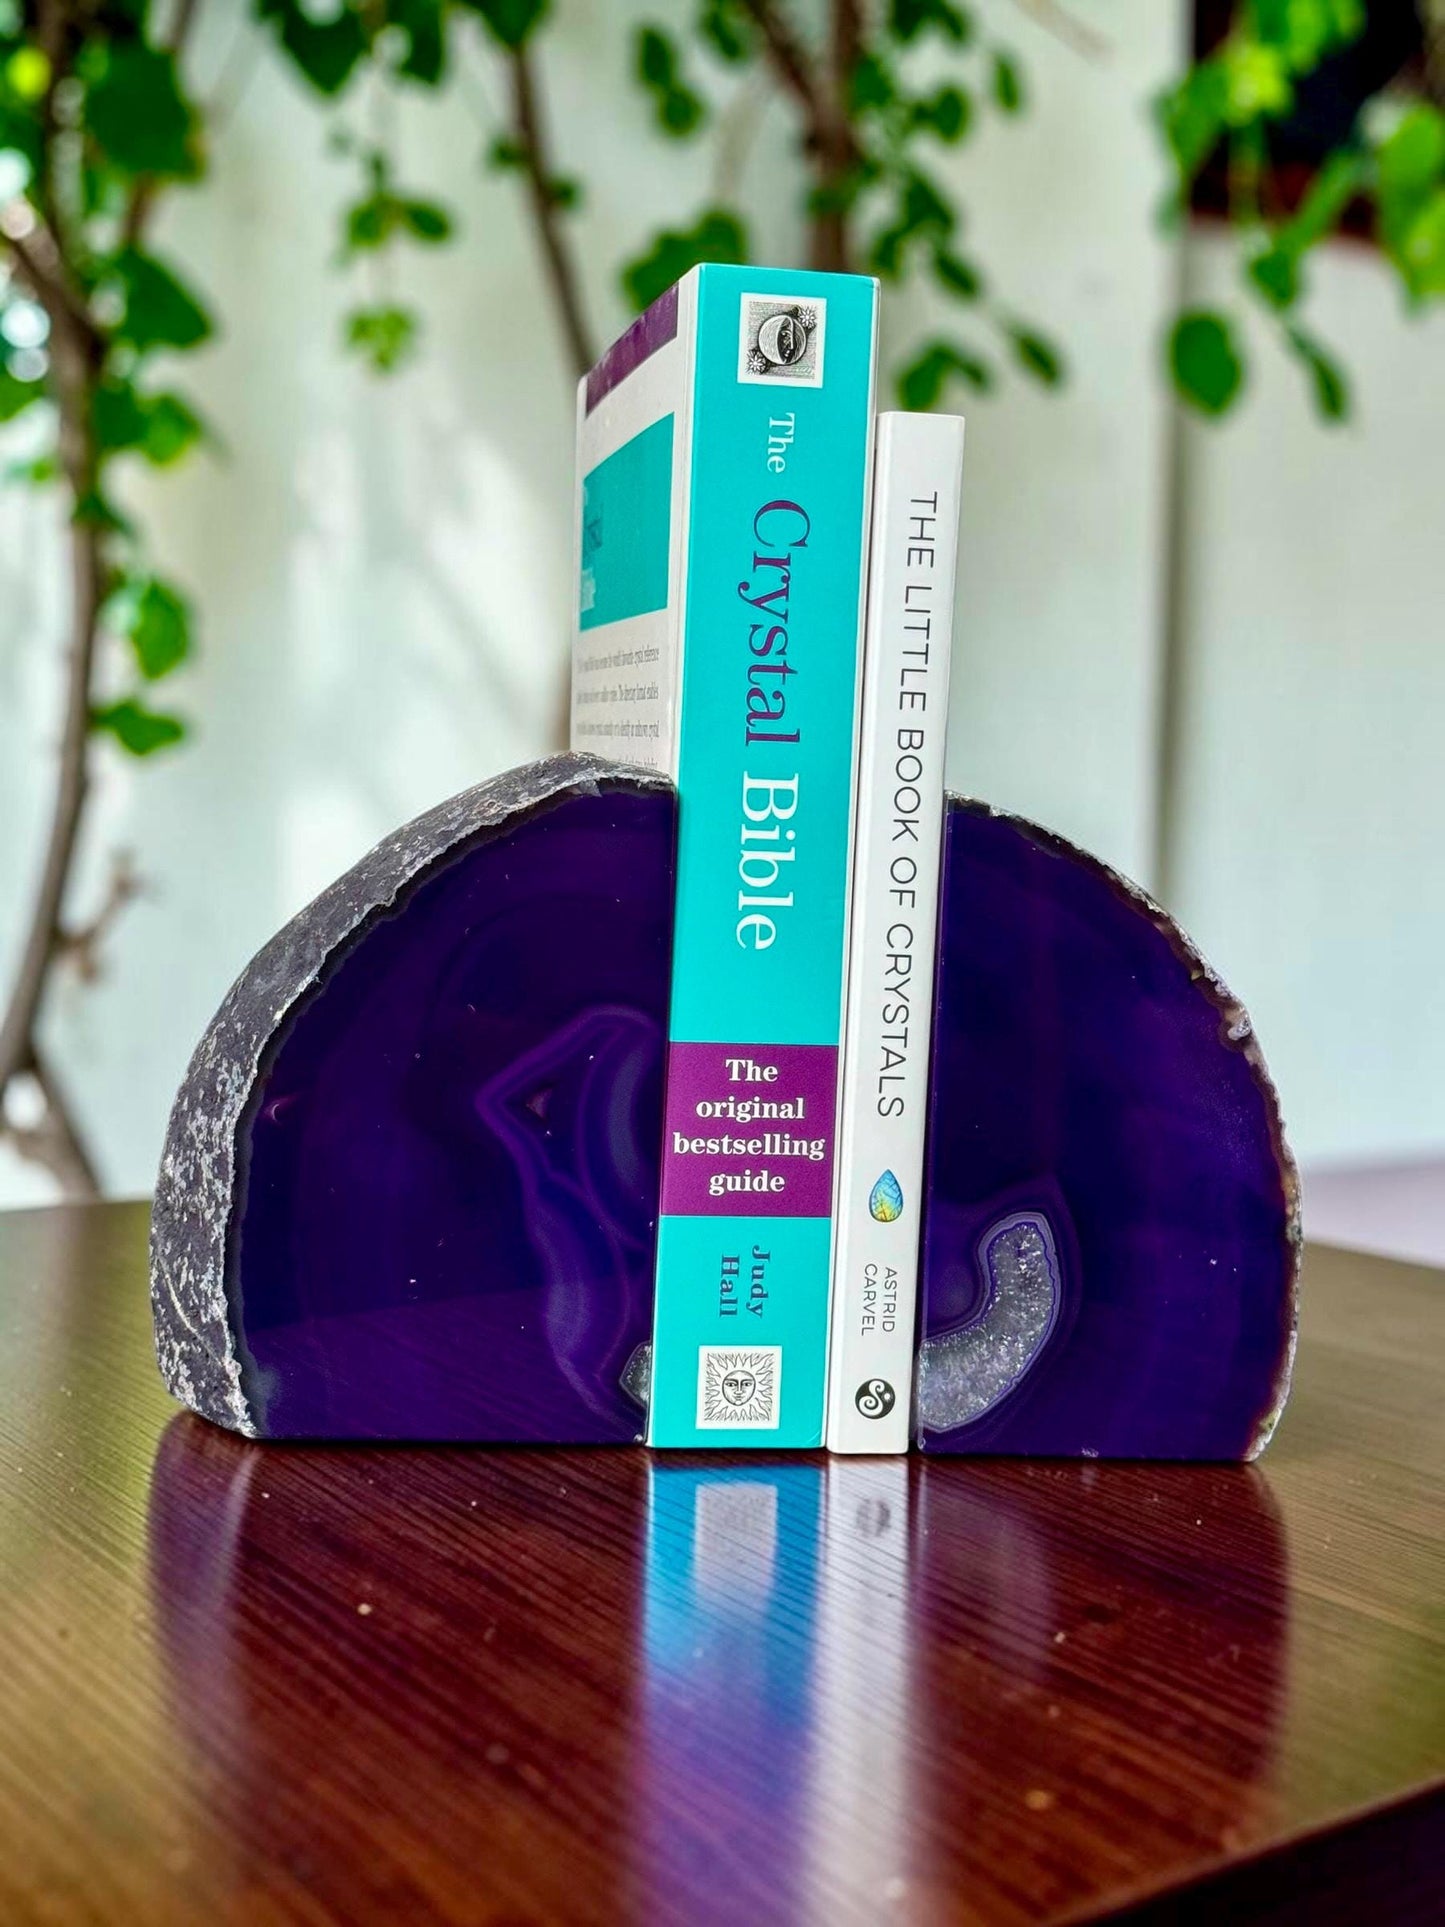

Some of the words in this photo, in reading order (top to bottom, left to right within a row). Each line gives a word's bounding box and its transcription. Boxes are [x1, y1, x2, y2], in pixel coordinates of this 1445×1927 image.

[767, 412, 795, 473] The
[907, 491, 937, 568] THE
[738, 499, 810, 746] Crystal
[899, 585, 933, 712] LITTLE
[891, 729, 924, 842] BOOK
[736, 771, 799, 950] Bible
[889, 857, 917, 909] OF
[877, 924, 914, 1117] CRYSTALS
[725, 1059, 778, 1082] The
[696, 1096, 805, 1123] original
[673, 1133, 826, 1161] bestselling
[709, 1169, 785, 1196] guide
[719, 1254, 740, 1318] Hall
[745, 1245, 771, 1318] Judy
[861, 1263, 878, 1336] CARVEL
[882, 1266, 897, 1333] ASTRID
